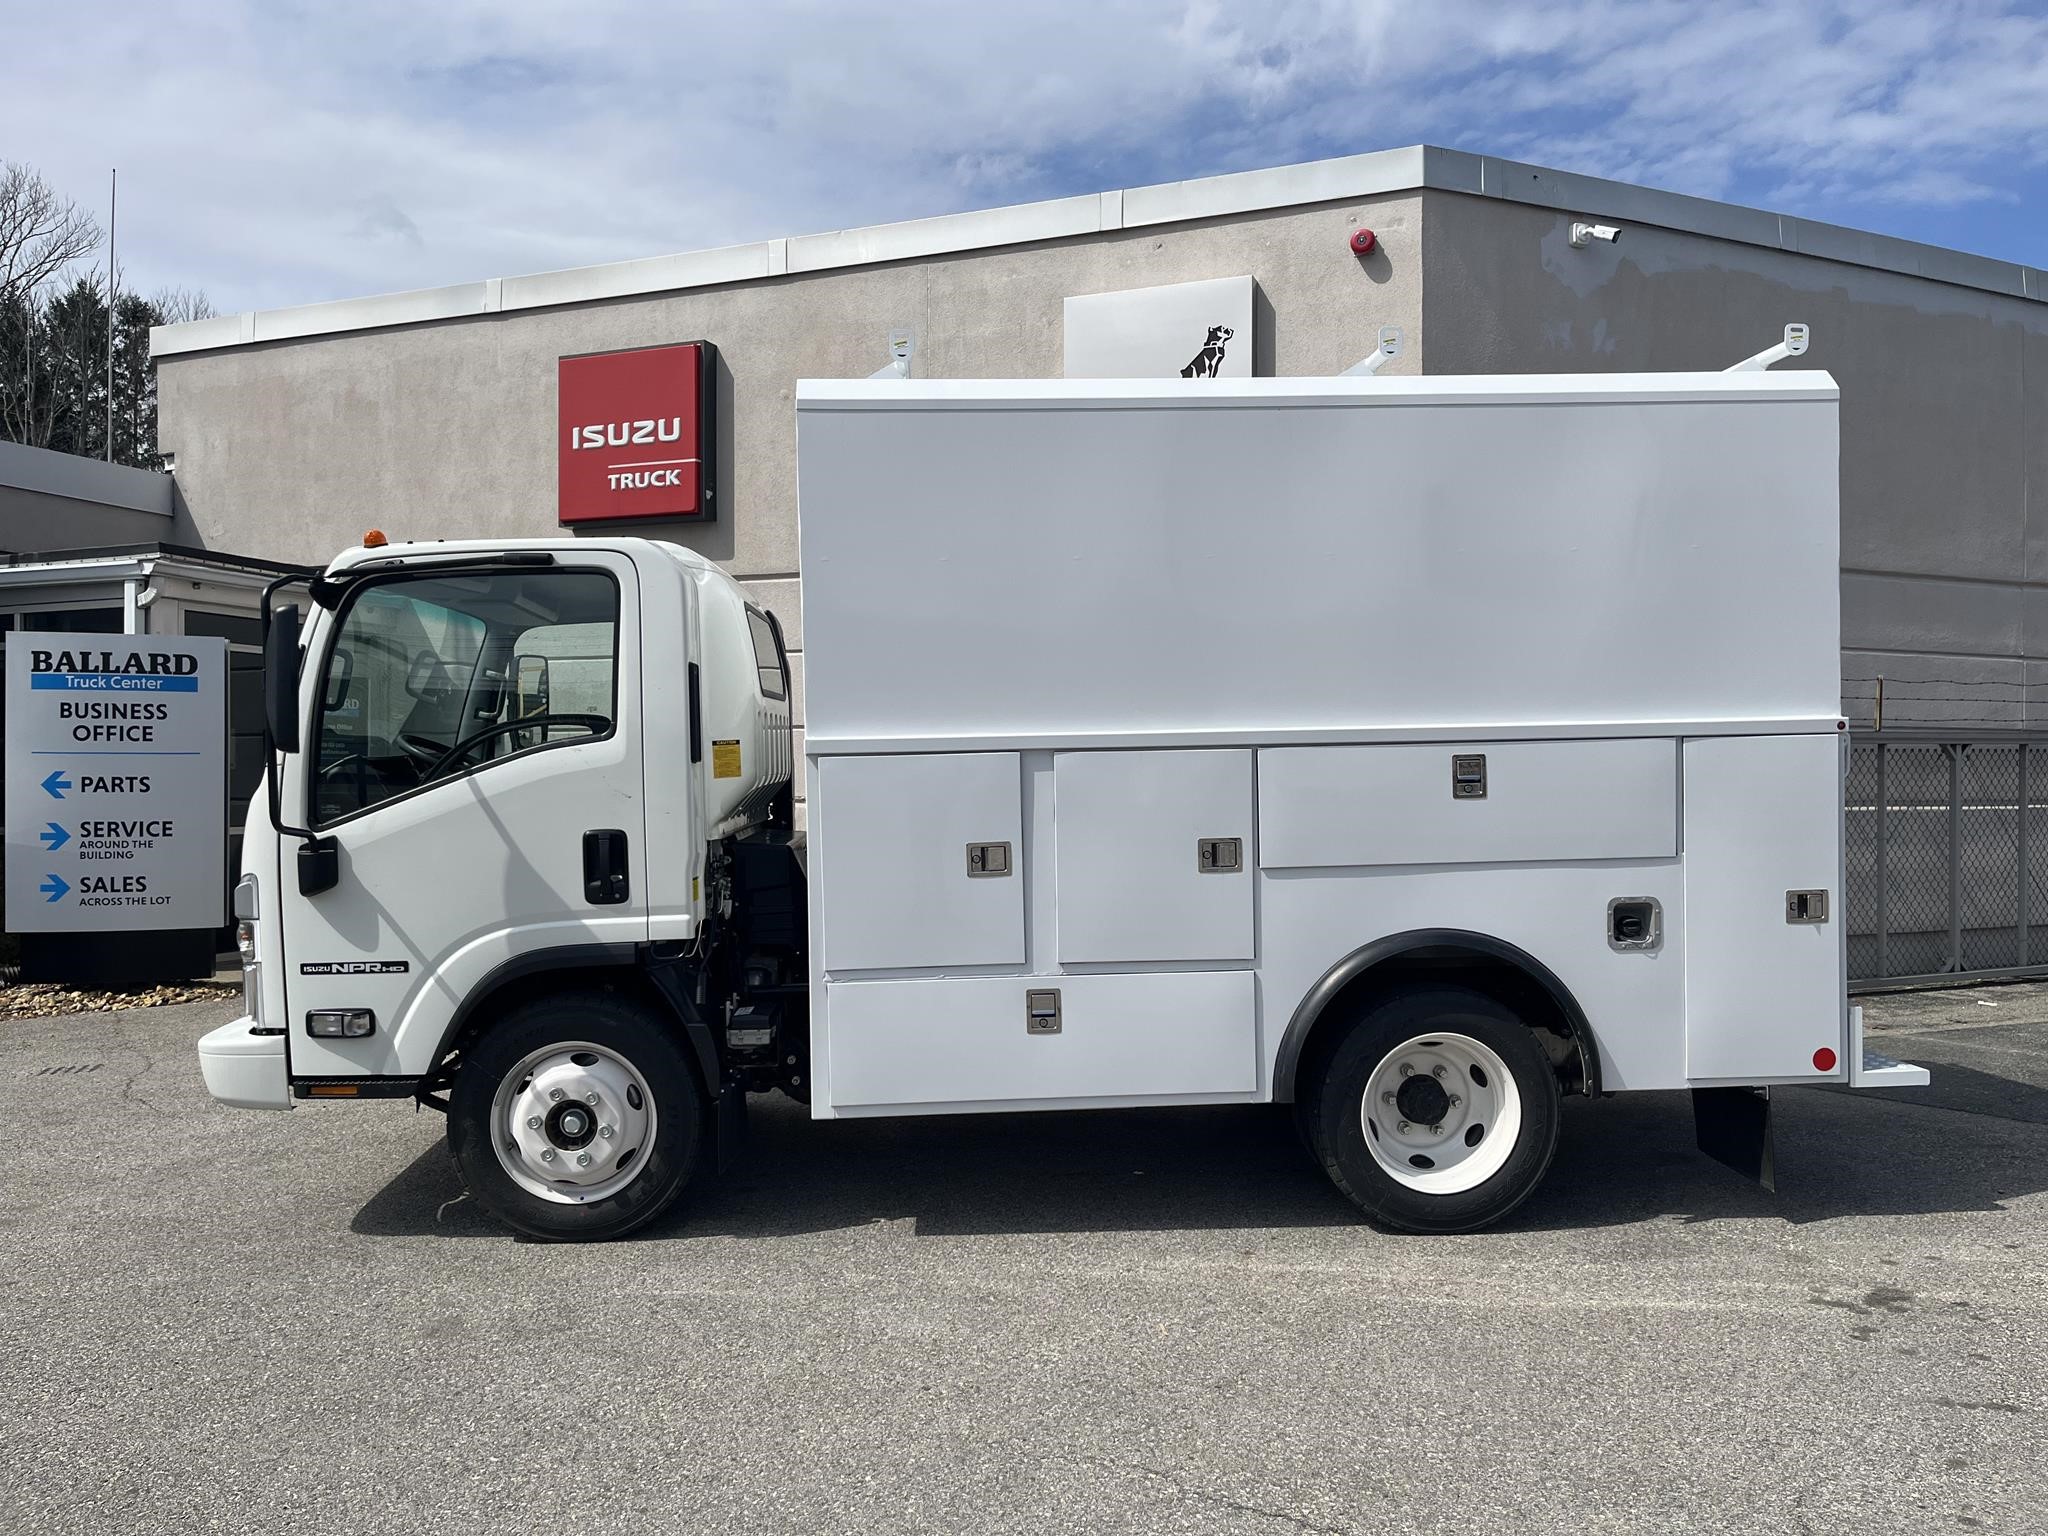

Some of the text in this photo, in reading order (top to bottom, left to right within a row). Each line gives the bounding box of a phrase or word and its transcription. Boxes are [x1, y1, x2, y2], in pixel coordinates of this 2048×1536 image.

[572, 417, 681, 450] ISUZU
[608, 469, 682, 491] TRUCK
[31, 650, 199, 676] BALLARD
[65, 675, 164, 690] Truck Center
[60, 702, 168, 721] BUSINESS
[72, 725, 154, 742] OFFICE
[81, 776, 151, 793] PARTS
[80, 821, 174, 838] SERVICE
[79, 840, 154, 850] AROUND THE
[79, 850, 134, 860] BUILDING
[80, 876, 147, 893] SALES
[79, 895, 172, 907] ACROSS THE LOT
[303, 965, 331, 973] ISUZU
[331, 962, 382, 974] NPR
